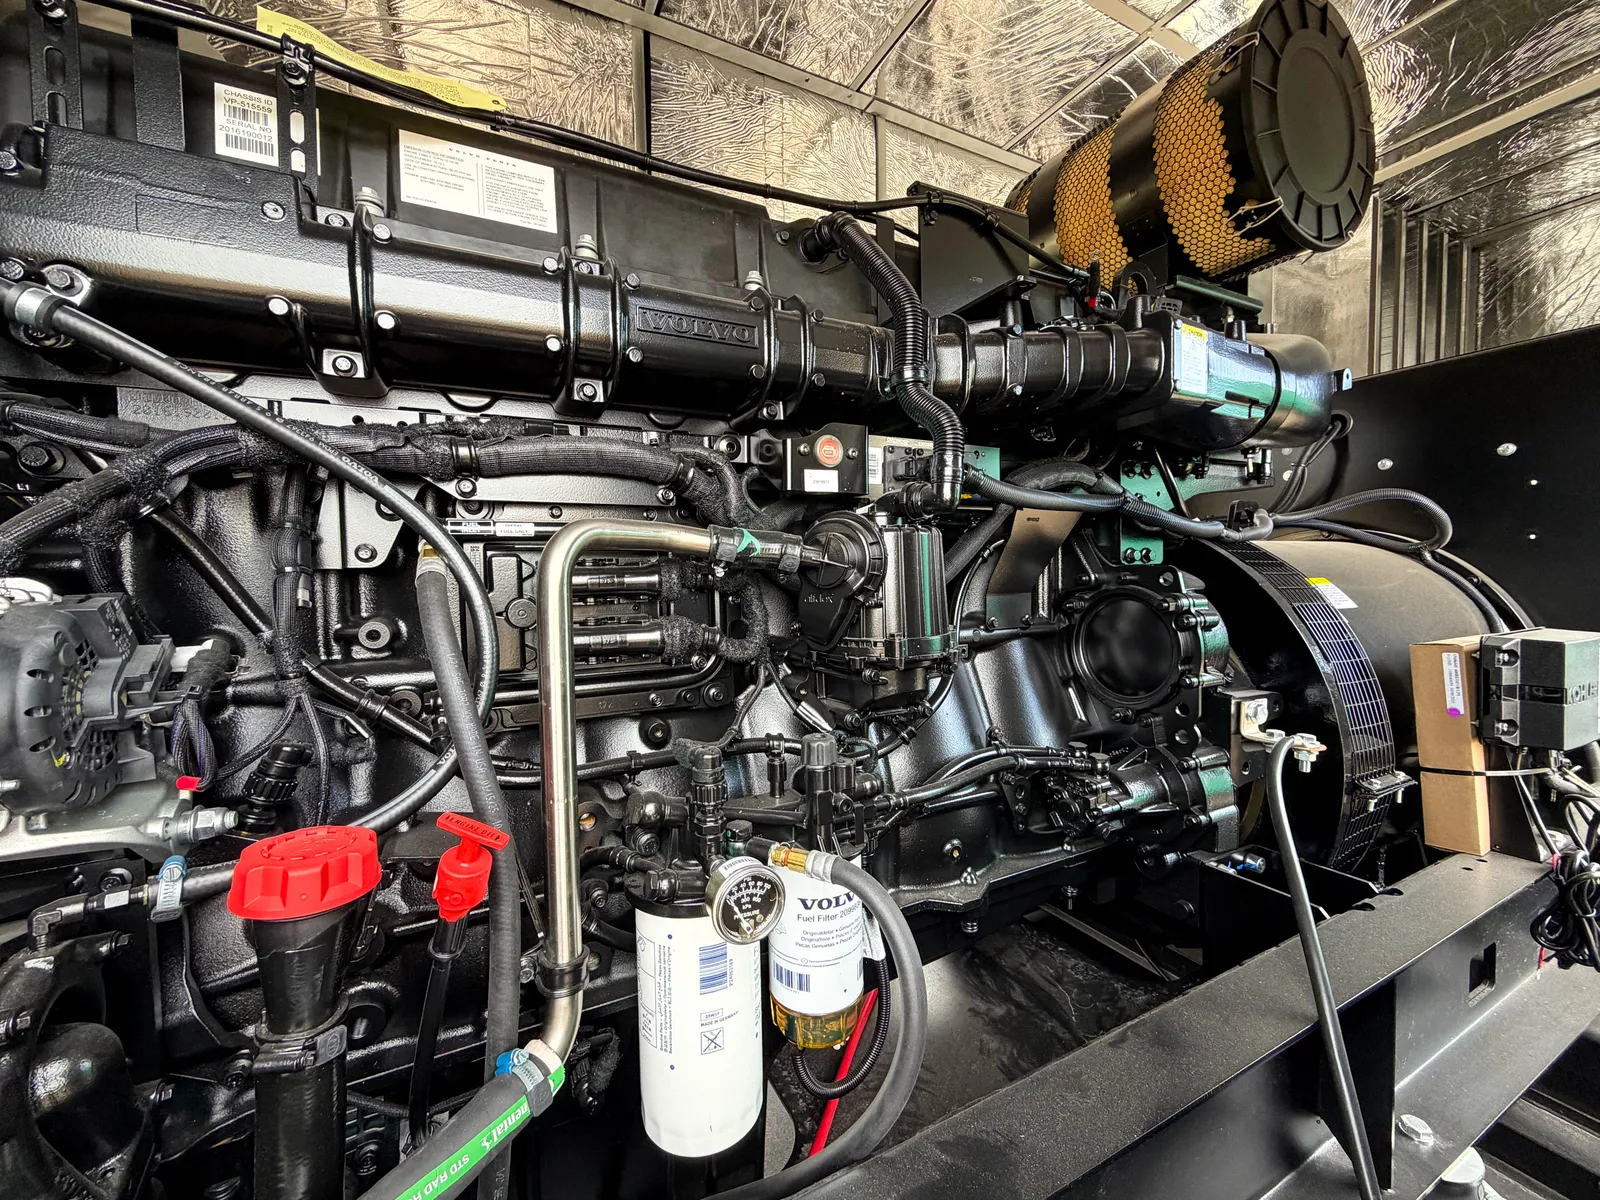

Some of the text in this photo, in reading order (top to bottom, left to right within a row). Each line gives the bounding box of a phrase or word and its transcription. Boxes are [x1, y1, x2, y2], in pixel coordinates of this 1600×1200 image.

[223, 89, 262, 104] CHASSIS
[223, 97, 272, 113] VP-515559
[226, 118, 257, 131] SERIAL
[219, 125, 273, 142] 2016190012
[642, 310, 755, 343] VOLVO
[173, 360, 217, 386] FRANCE
[286, 424, 315, 442] 943367
[319, 441, 339, 456] EPDM
[341, 456, 380, 484] VOLVO
[452, 672, 465, 686] SAE
[471, 744, 484, 756] IN
[475, 757, 488, 775] USA
[449, 816, 496, 838] ENGINE OIL
[200, 859, 240, 871] FRANC
[797, 891, 855, 910] VOLV
[797, 913, 815, 922] Fuel
[818, 913, 839, 922] Filter
[719, 1010, 739, 1023] GERMANY
[450, 1154, 470, 1175] STD
[424, 1171, 449, 1195] RAD
